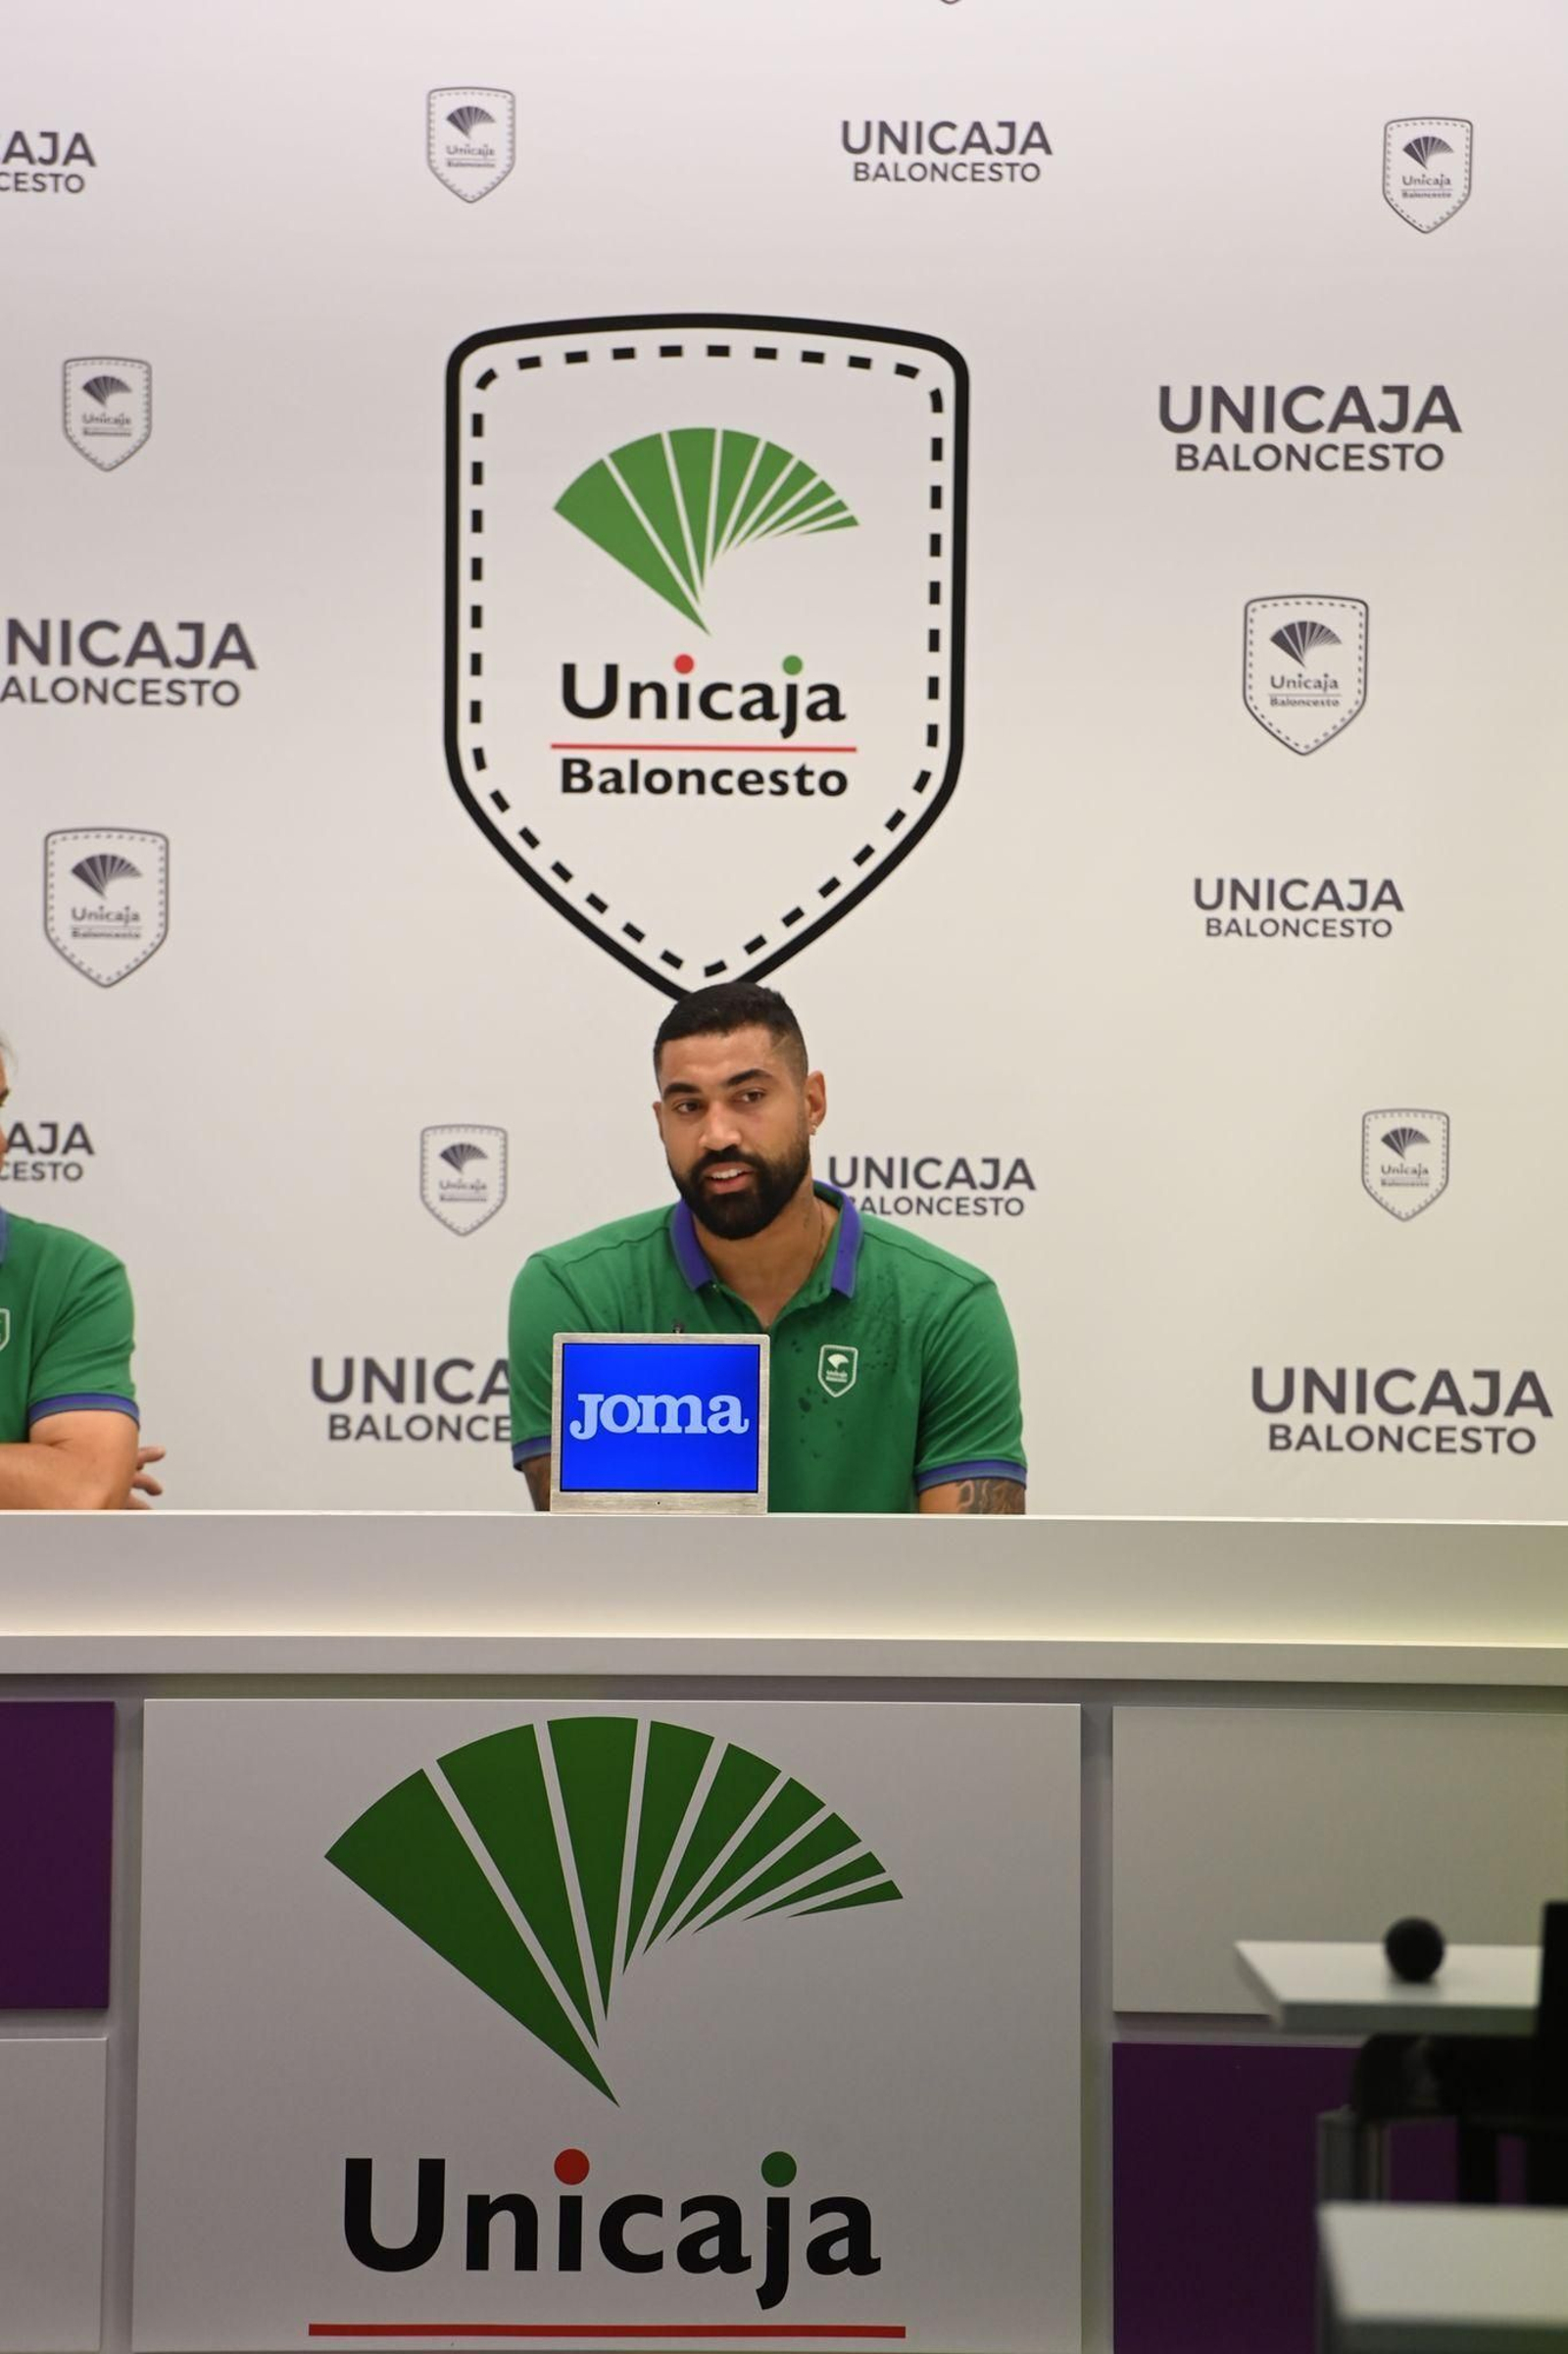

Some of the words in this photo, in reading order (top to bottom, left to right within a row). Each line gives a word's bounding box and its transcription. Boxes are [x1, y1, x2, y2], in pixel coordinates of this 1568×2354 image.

[842, 120, 1054, 155] UNICAJA
[853, 162, 1041, 183] BALONCESTO
[1402, 173, 1451, 188] Unicaja
[1159, 385, 1463, 434] UNICAJA
[1176, 443, 1444, 472] BALONCESTO
[7, 618, 258, 670] NICAJA
[563, 655, 846, 739] Unicaja
[1270, 672, 1339, 693] Unicaja
[562, 759, 848, 797] Baloncesto
[1194, 877, 1404, 912] UNICAJA
[72, 905, 141, 925] Unicaja
[1205, 918, 1393, 939] BALONCESTO
[828, 1156, 1037, 1191] UNICAJA
[1381, 1162, 1430, 1178] Unicaja
[850, 1196, 1025, 1216] ALONCESTO
[1252, 1366, 1554, 1418] UNICAJA
[1269, 1424, 1537, 1455] BALONCESTO
[344, 2149, 881, 2311] Unicaja
